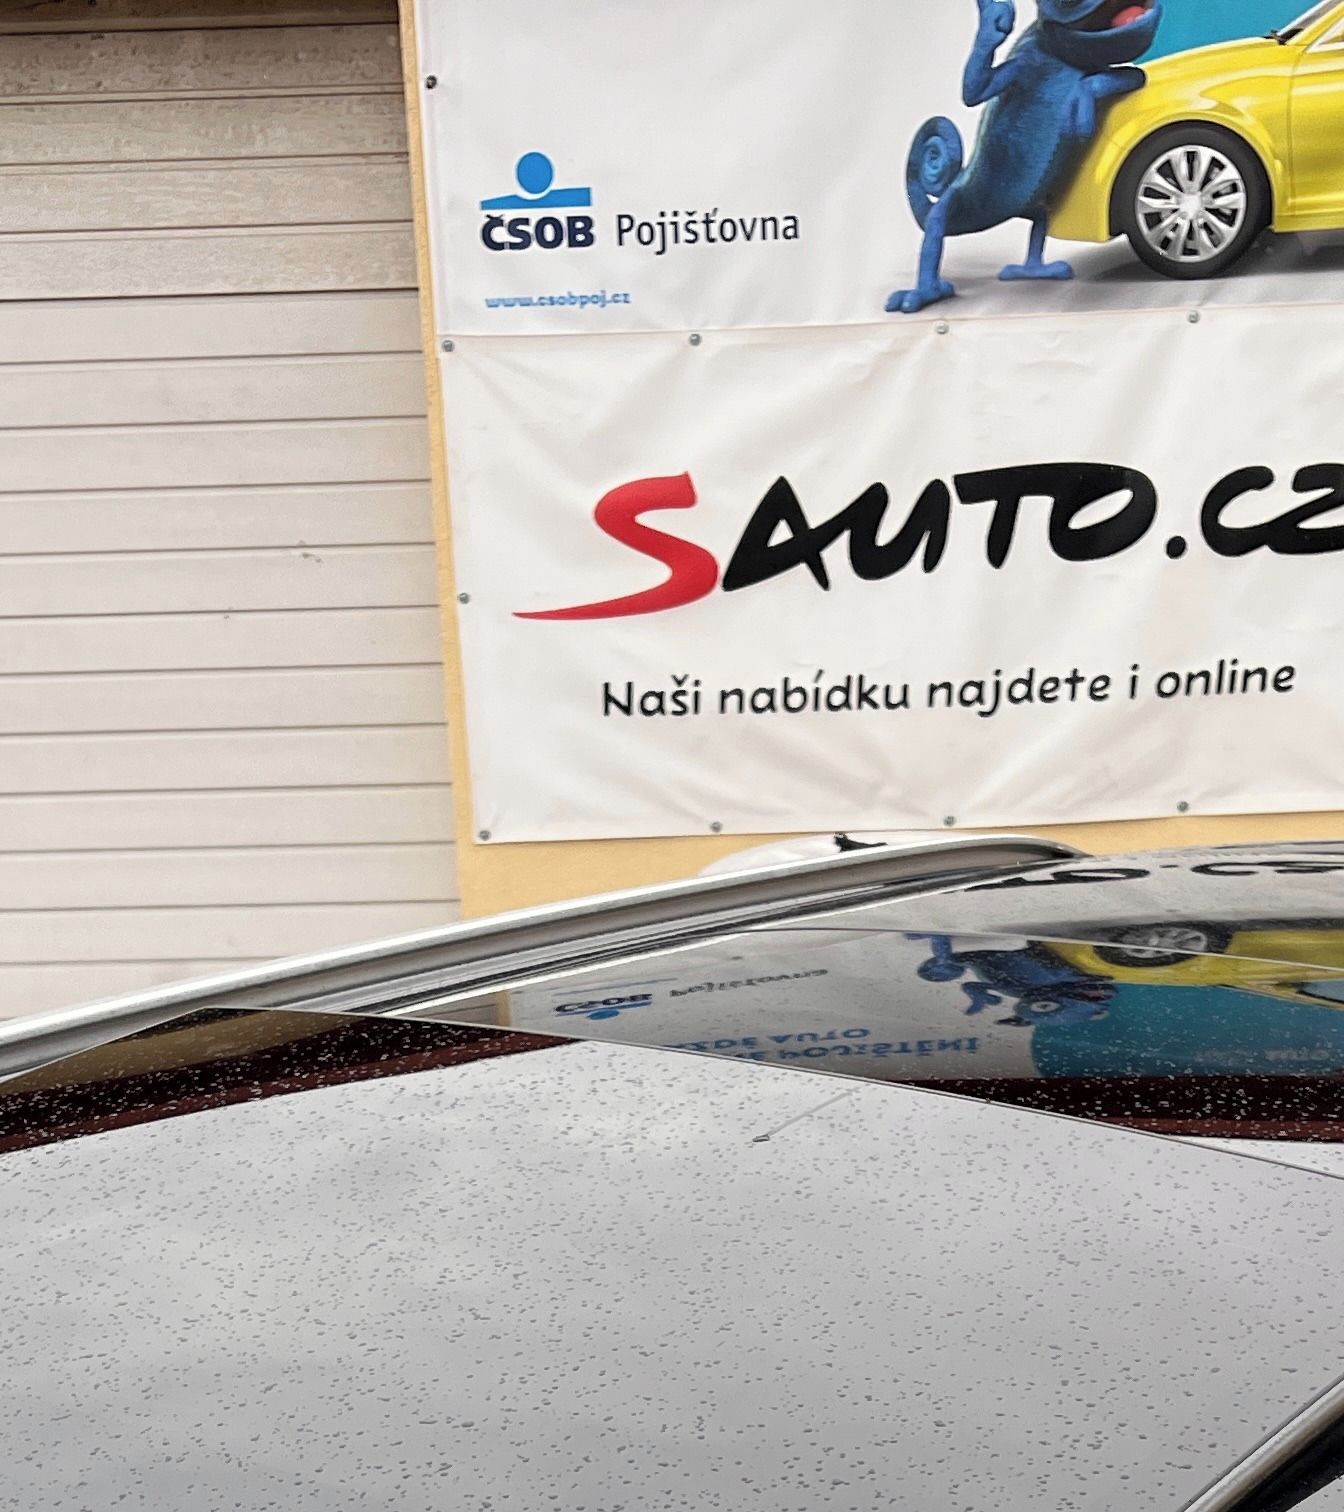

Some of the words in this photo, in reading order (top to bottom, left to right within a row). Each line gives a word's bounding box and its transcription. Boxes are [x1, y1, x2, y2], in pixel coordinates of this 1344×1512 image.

[481, 213, 595, 252] ČSOB
[616, 207, 800, 256] Pojišťovna
[484, 290, 632, 310] www.csobpoj.cz
[602, 673, 702, 717] Naši
[718, 669, 910, 715] nabídku
[927, 667, 1112, 718] najdete
[1129, 663, 1141, 700] i
[1155, 658, 1296, 699] online
